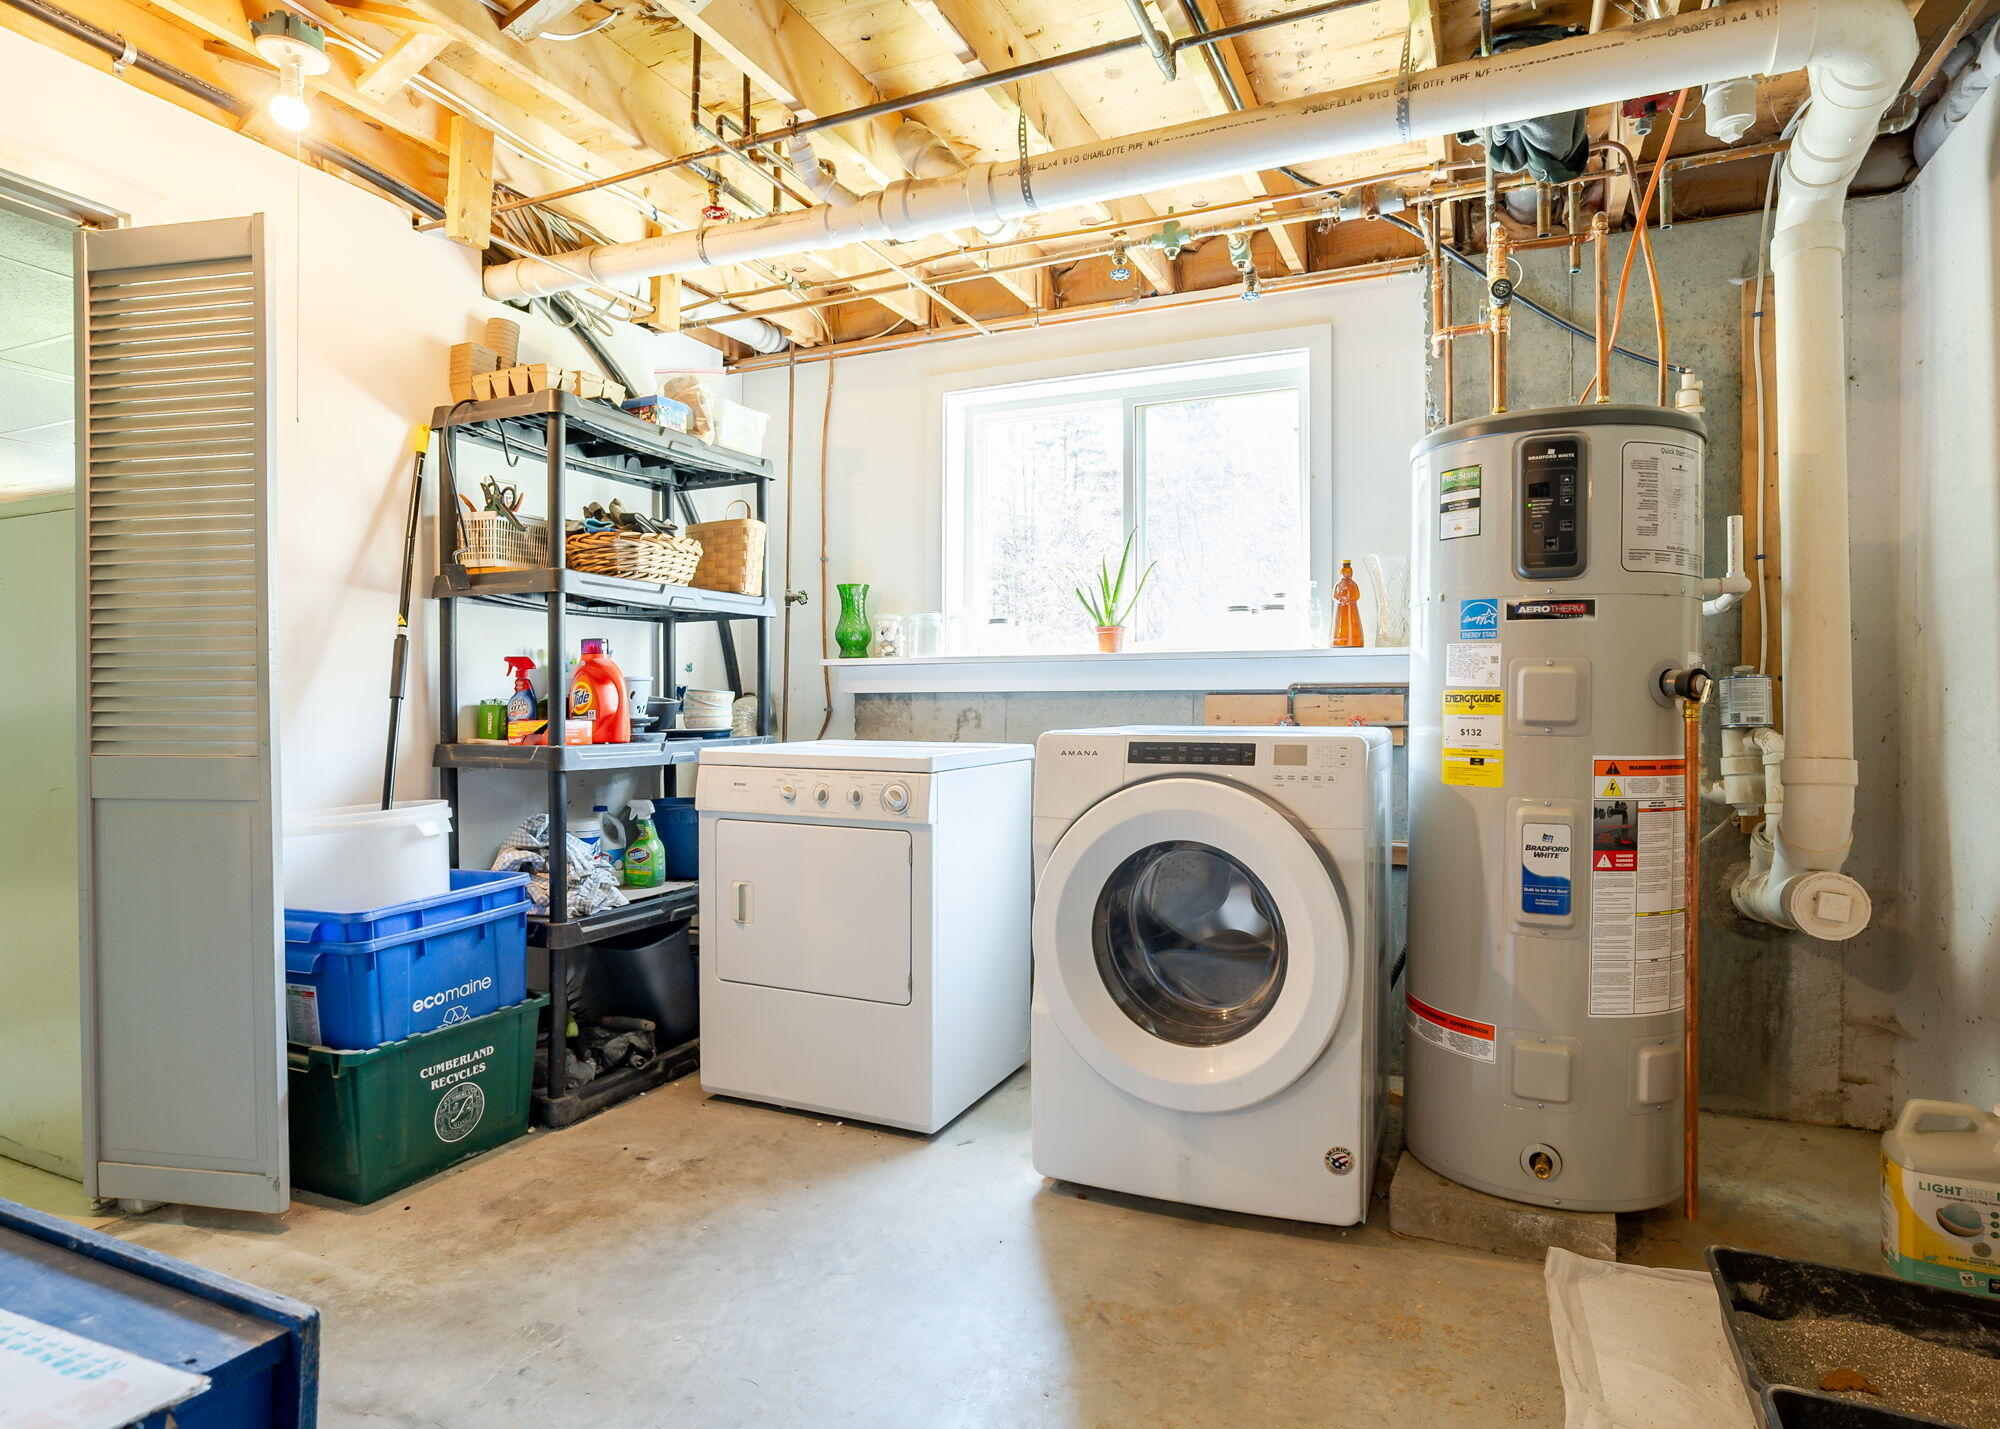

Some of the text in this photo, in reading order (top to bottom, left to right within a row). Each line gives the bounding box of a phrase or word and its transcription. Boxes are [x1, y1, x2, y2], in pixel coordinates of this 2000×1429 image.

[1082, 145, 1125, 161] CHARLOTTE
[1527, 453, 1557, 461] BRADFORD
[1660, 447, 1675, 456] Quick
[1675, 449, 1686, 457] Start
[1458, 471, 1479, 480] State
[1518, 603, 1585, 614] AEROTHERM
[1461, 630, 1498, 639] ENERGY STAR
[573, 689, 590, 708] Tide
[1460, 728, 1482, 737] $132
[1525, 844, 1570, 853] BRADFORD
[412, 976, 492, 1013] ecomaine
[419, 1045, 495, 1079] CUMBERLAND
[430, 1062, 487, 1091] RECYCLES
[1919, 1181, 1963, 1196] LIGHT
